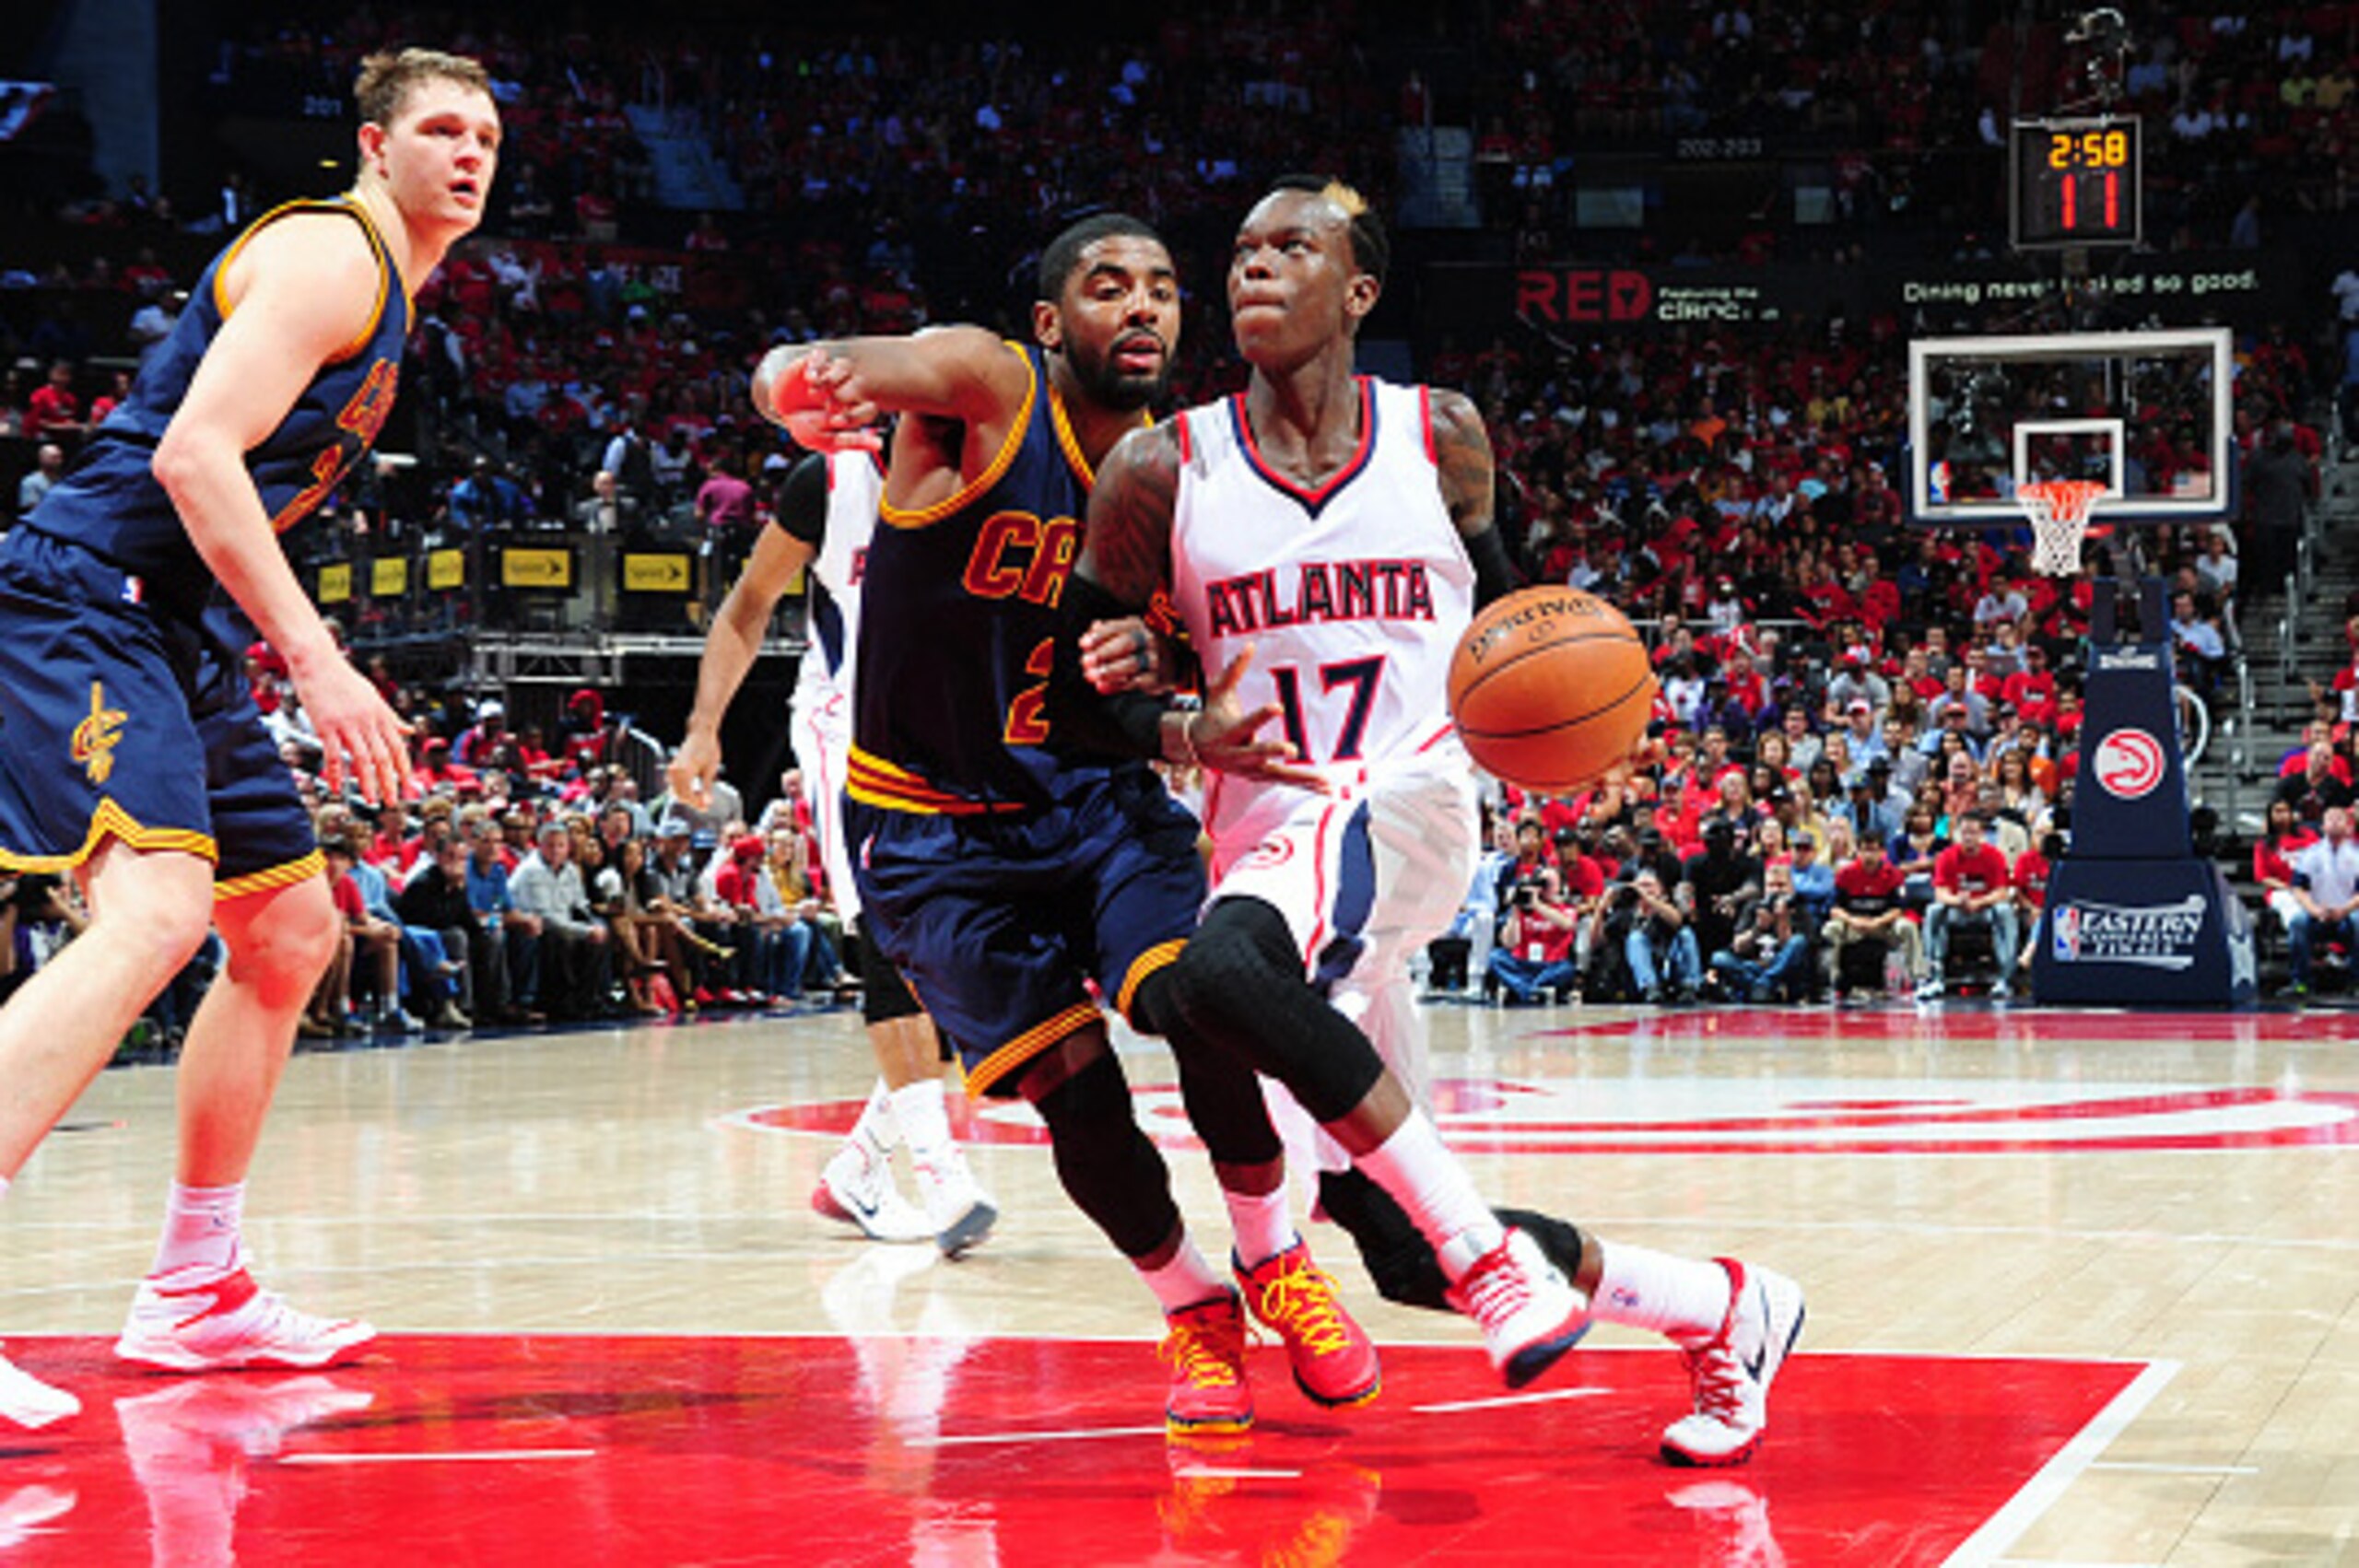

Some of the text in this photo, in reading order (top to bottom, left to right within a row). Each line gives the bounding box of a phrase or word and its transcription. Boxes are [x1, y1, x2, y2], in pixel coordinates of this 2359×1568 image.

[2048, 131, 2129, 170] 2:58
[2060, 170, 2118, 230] 11
[1517, 271, 1651, 322] RED
[1904, 282, 1980, 305] Dining
[2153, 275, 2184, 292] so
[1204, 557, 1438, 639] ATLANTA
[1268, 653, 1386, 766] 17
[2079, 911, 2203, 933] EASTERN
